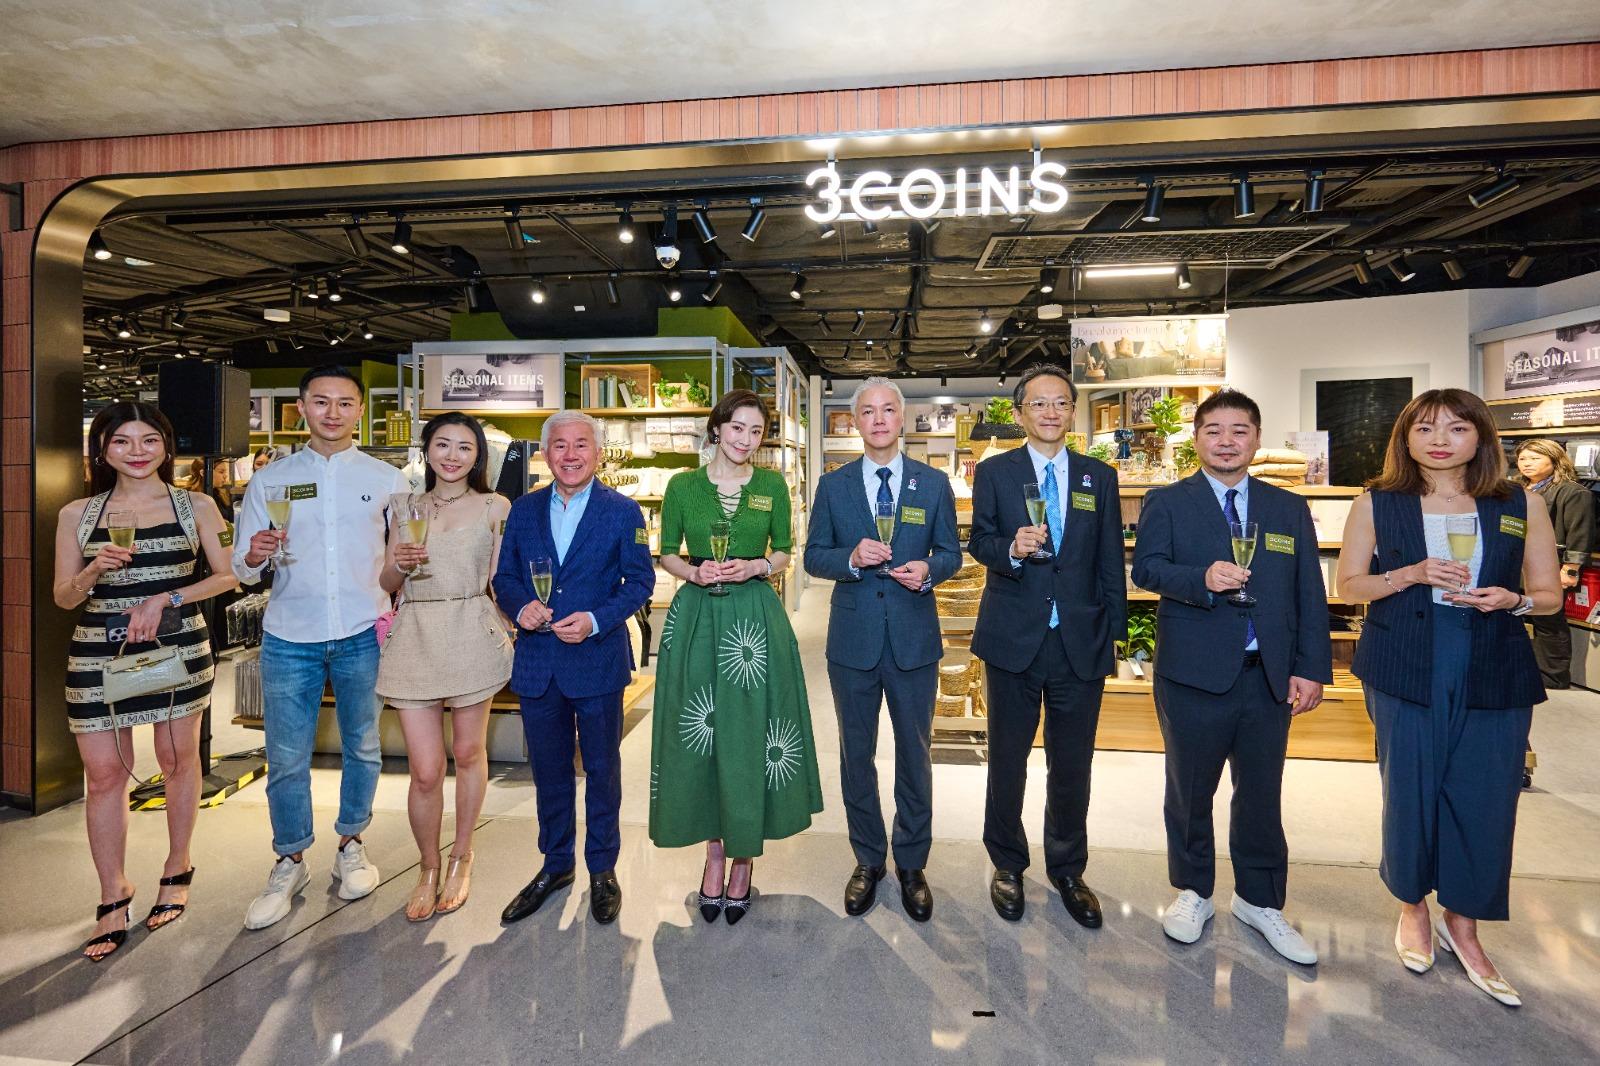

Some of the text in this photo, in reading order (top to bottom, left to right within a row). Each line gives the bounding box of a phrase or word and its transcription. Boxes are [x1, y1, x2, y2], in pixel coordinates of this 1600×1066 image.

[805, 162, 1068, 222] 3COINS
[1506, 350, 1582, 373] SEASONAL
[443, 374, 544, 386] SEASONAL ITEMS
